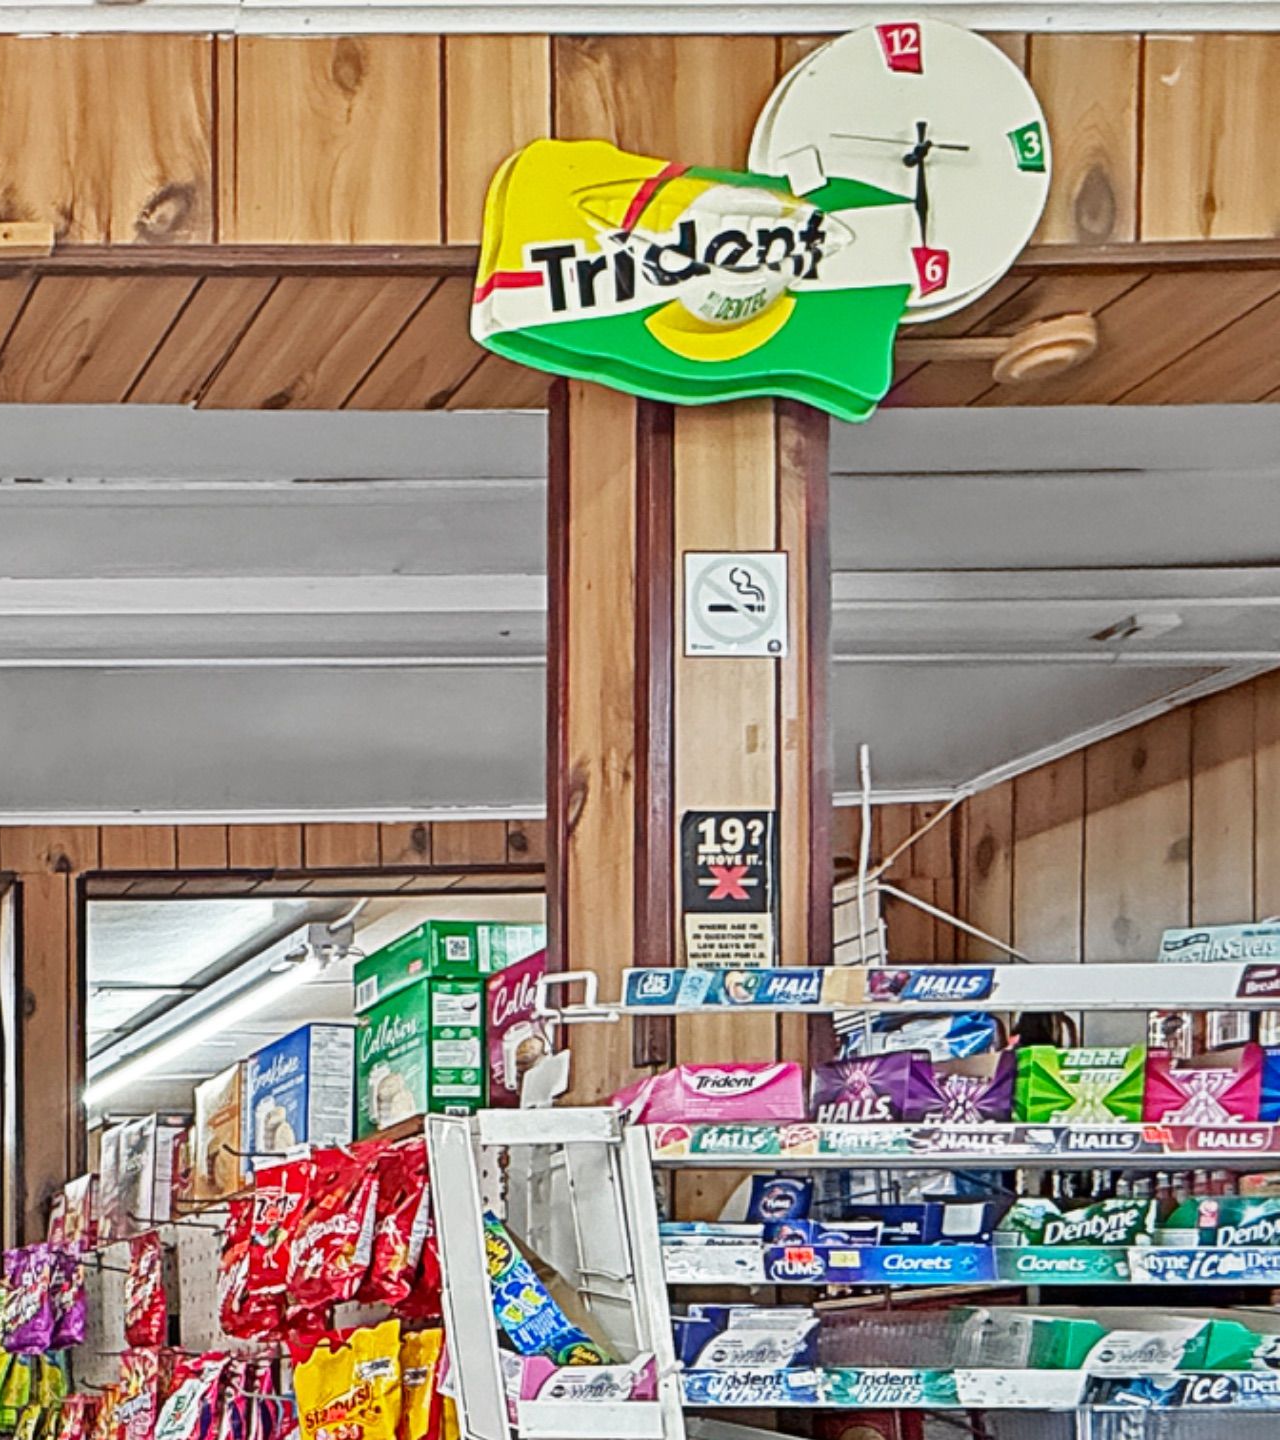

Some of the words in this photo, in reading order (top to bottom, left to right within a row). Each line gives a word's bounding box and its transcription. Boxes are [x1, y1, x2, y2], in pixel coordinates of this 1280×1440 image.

[885, 28, 919, 55] 12
[1023, 131, 1040, 156] 3
[531, 210, 827, 311] Trident
[925, 257, 941, 283] 6
[698, 819, 765, 853] 19?
[698, 855, 740, 866] PROVE
[743, 854, 763, 866] IT.
[913, 975, 983, 994] HALLS
[695, 1075, 757, 1090] Trident
[701, 1130, 768, 1149] HALLS
[939, 1131, 1005, 1149] HALLS
[1069, 1131, 1135, 1149] HALLS
[1197, 1130, 1264, 1149] HALLS
[1043, 1207, 1139, 1246] Dentyne
[882, 1254, 952, 1271] Clorets
[1016, 1253, 1087, 1272] Clorets
[854, 1370, 922, 1386] Trident
